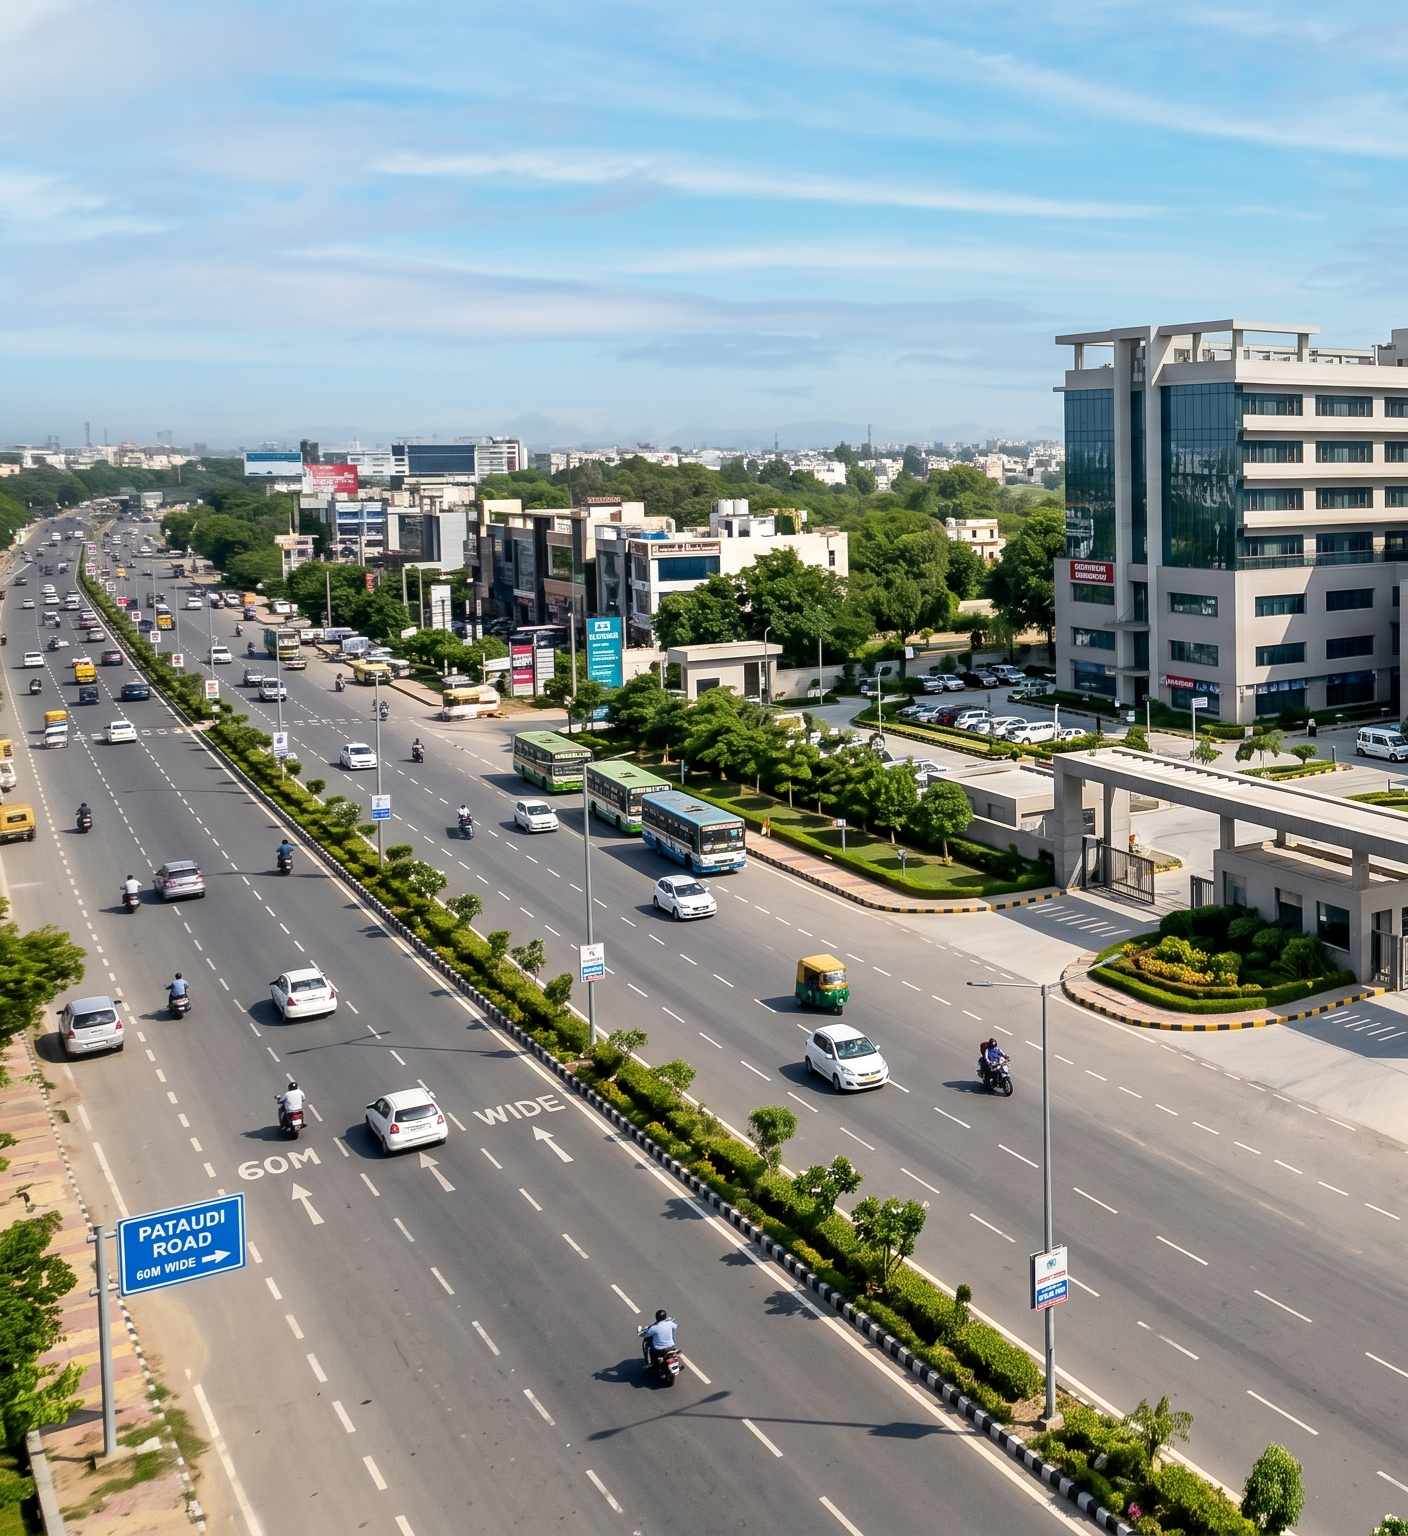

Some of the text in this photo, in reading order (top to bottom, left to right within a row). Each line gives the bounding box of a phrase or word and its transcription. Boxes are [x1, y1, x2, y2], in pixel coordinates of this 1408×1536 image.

[238, 1094, 567, 1180] 60M WIDE
[140, 1210, 225, 1242] PATAUDI
[153, 1232, 212, 1258] ROAD
[136, 1257, 196, 1281] 60M WIDE
